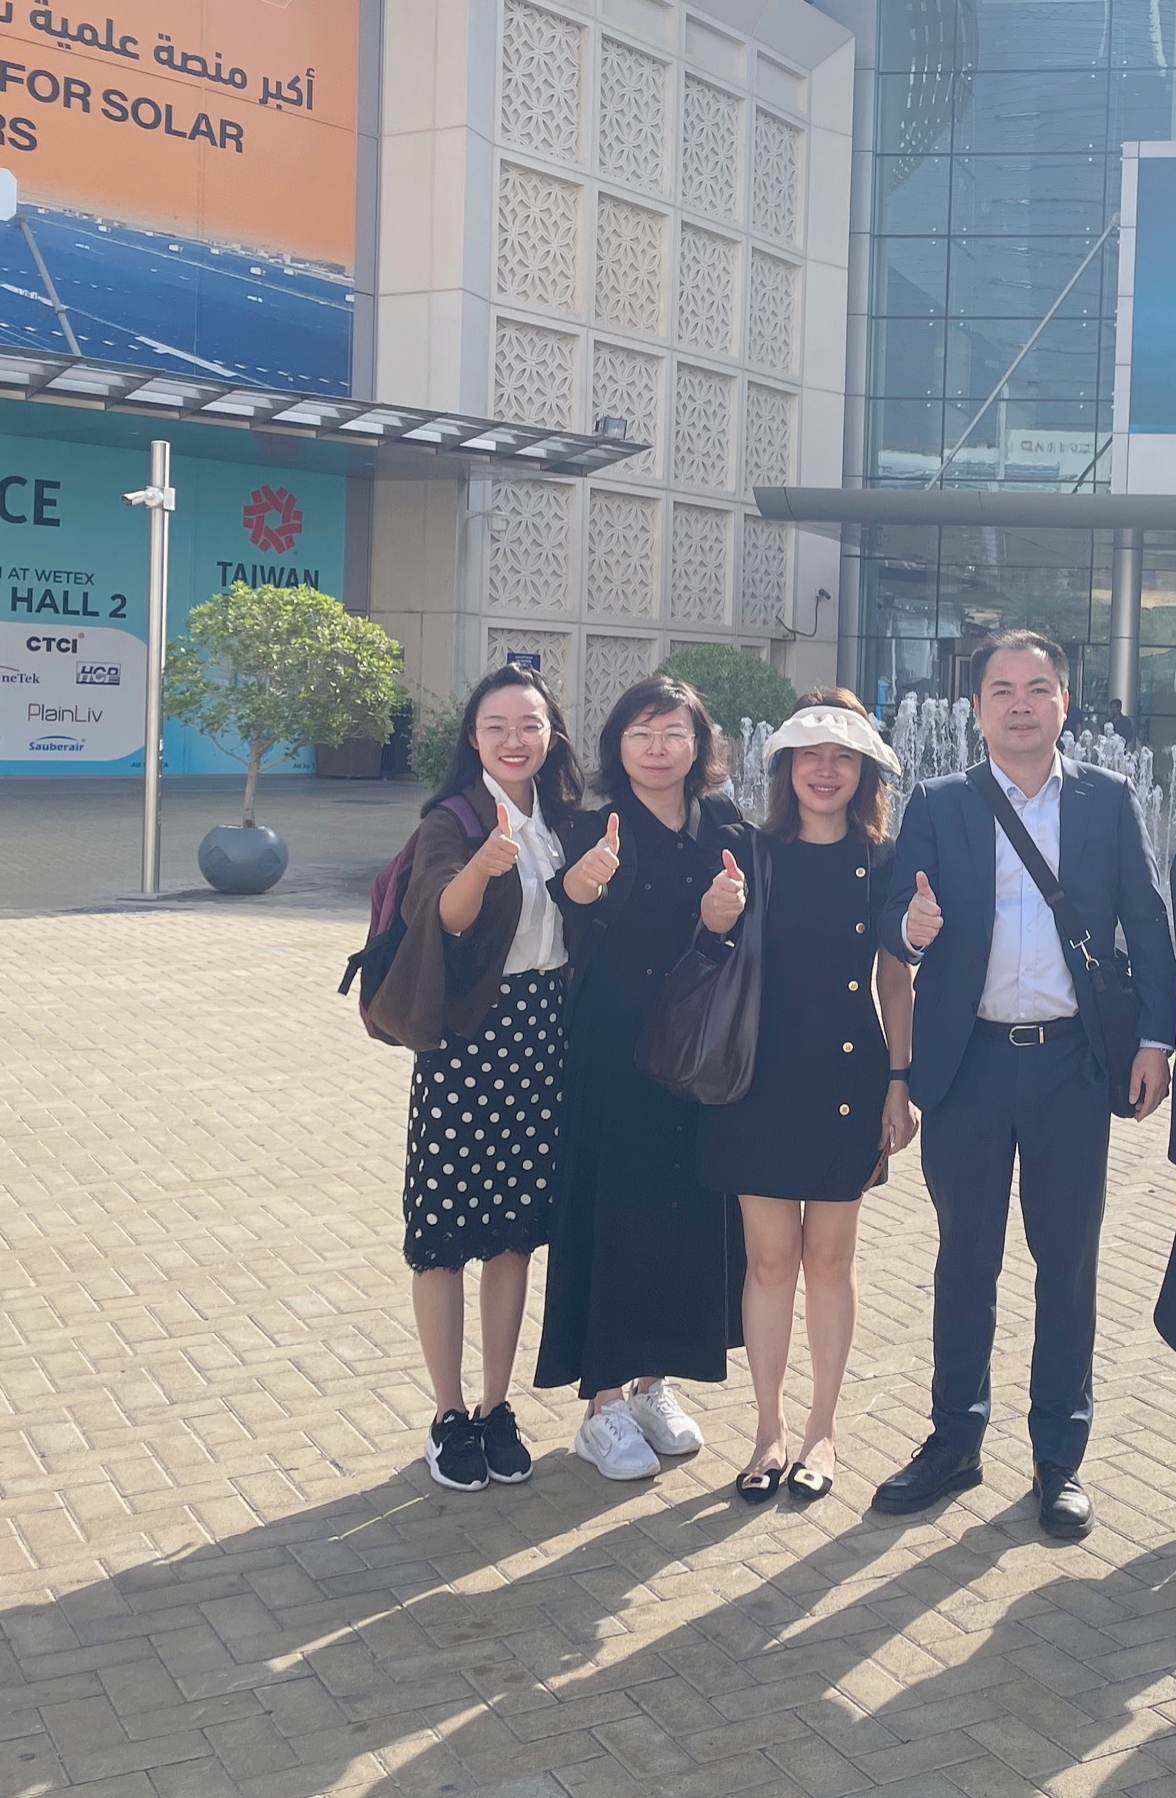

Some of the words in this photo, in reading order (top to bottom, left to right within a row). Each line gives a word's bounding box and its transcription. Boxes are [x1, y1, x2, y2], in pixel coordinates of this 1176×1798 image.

[29, 0, 140, 60] علمية
[153, 33, 248, 89] منصة
[259, 67, 315, 110] أكبر
[0, 59, 92, 114] FOR
[101, 88, 244, 153] SOLAR
[8, 567, 30, 581] AT
[34, 568, 95, 586] WETEX
[217, 561, 319, 591] TAIWAN
[10, 586, 100, 617] HALL
[108, 593, 127, 619] 2
[26, 636, 78, 653] CTCI
[28, 703, 103, 723] PlainLiv
[29, 742, 84, 752] Sauberair
